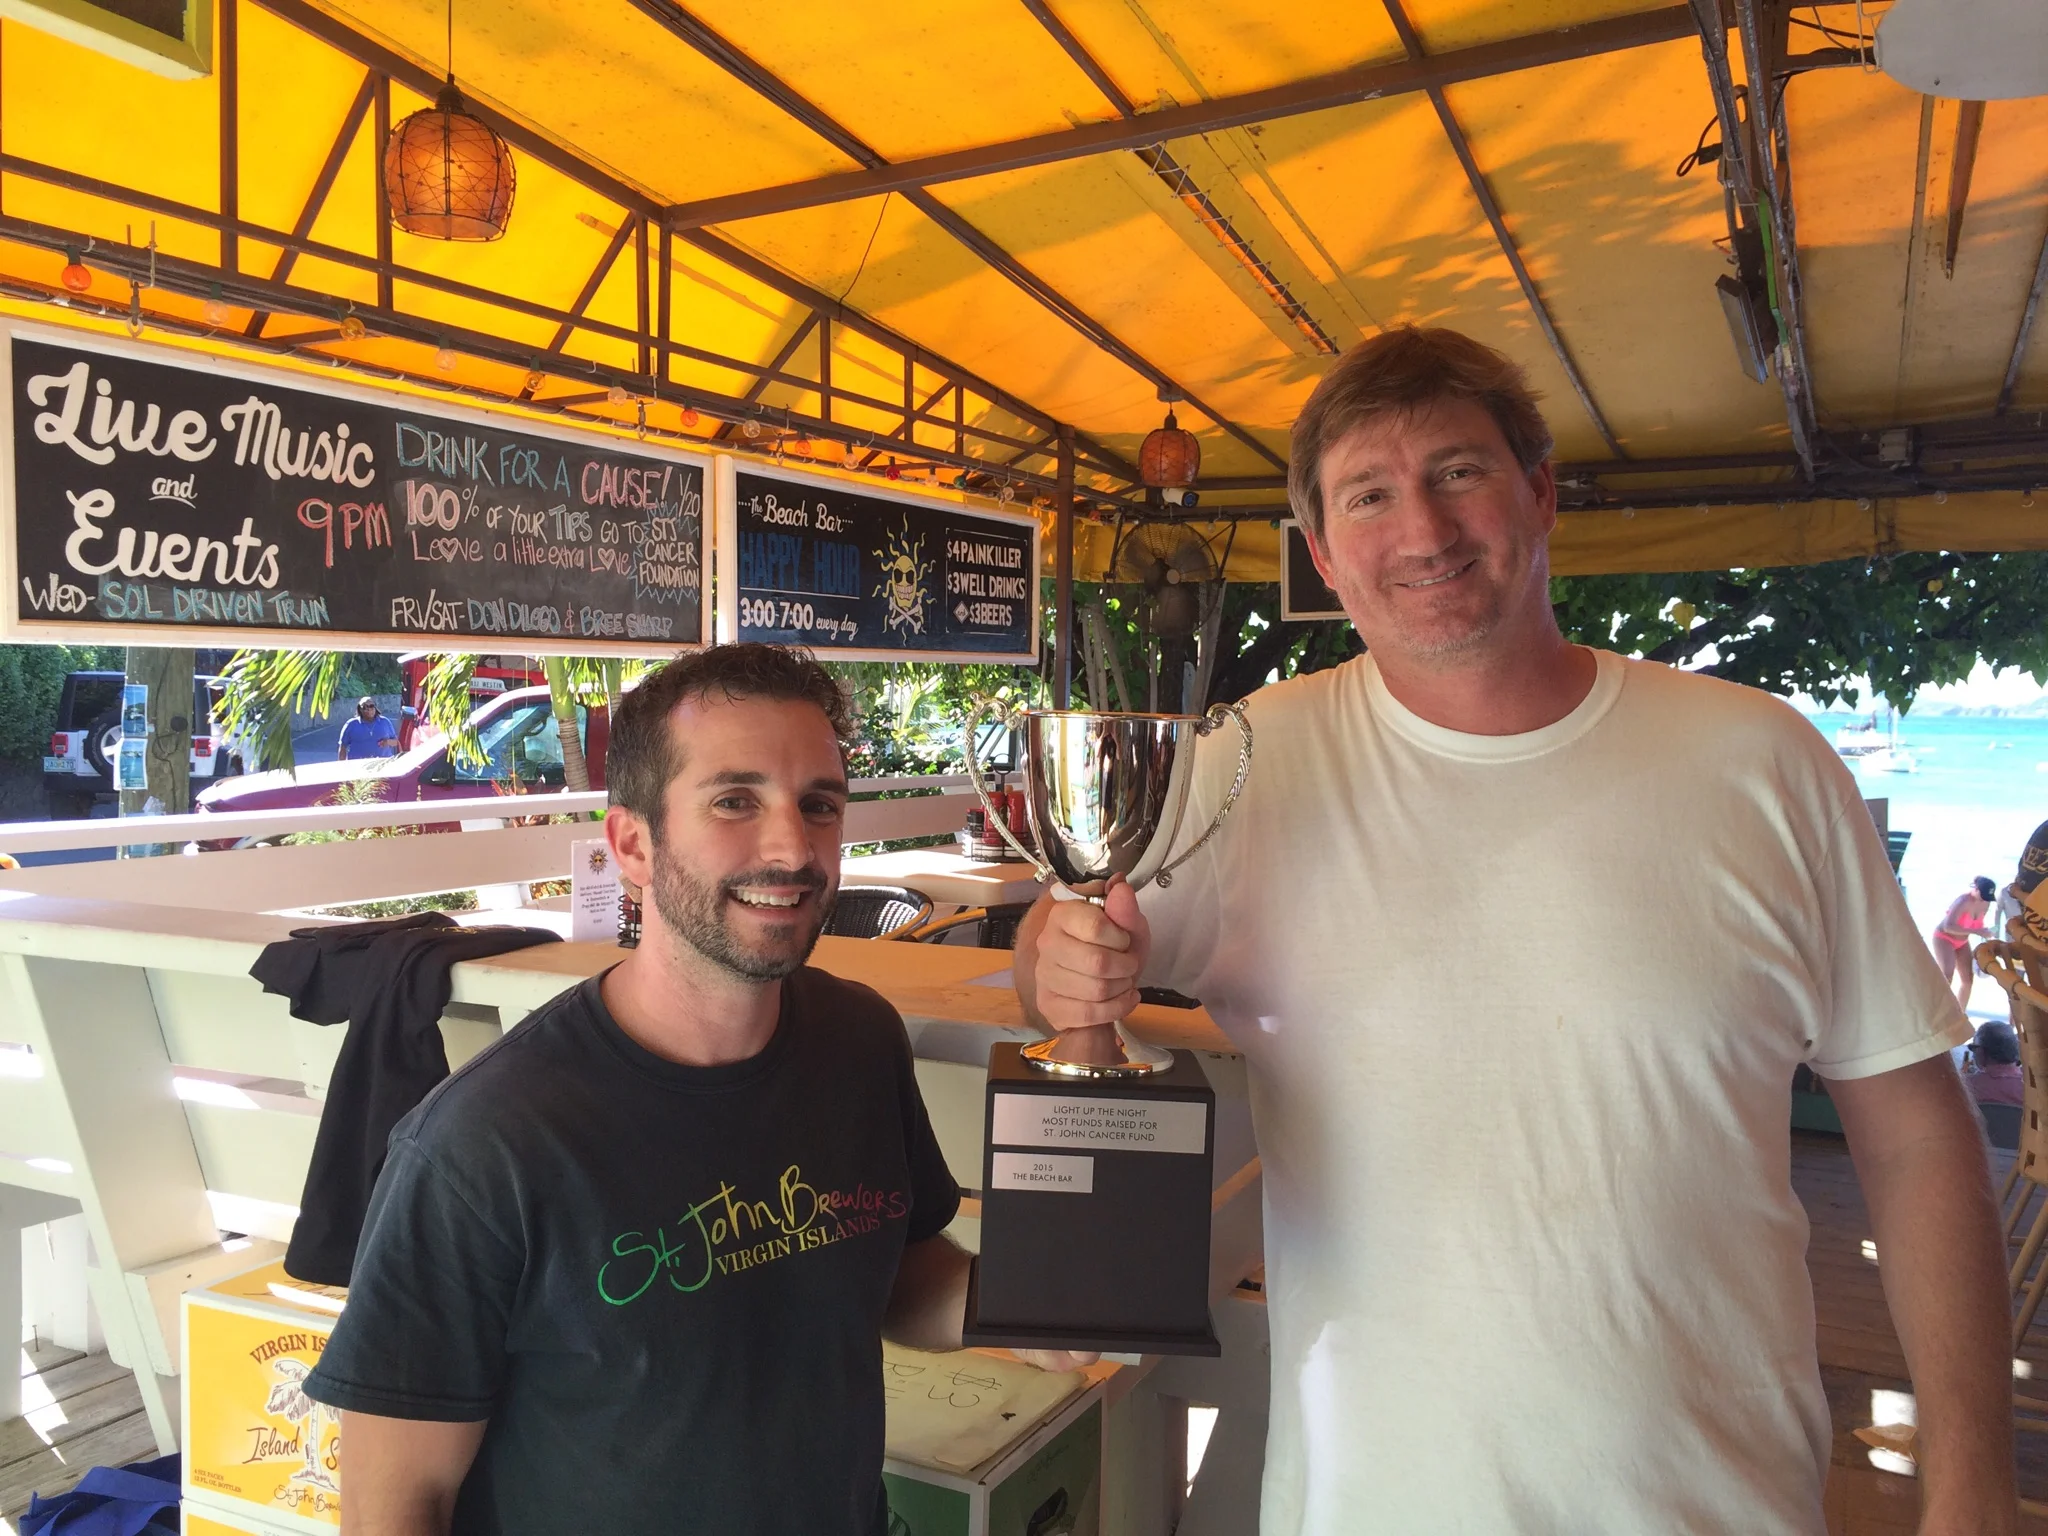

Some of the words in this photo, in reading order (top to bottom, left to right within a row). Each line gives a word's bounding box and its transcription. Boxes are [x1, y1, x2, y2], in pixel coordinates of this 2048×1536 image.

[27, 362, 217, 465] Live
[221, 396, 375, 488] Music
[396, 422, 495, 488] DRINK
[499, 444, 547, 491] FOR
[554, 456, 571, 497] A
[581, 461, 674, 510] CAUSE!
[151, 474, 198, 499] and
[406, 480, 480, 531] 100%
[486, 506, 503, 530] OF
[508, 504, 548, 544] YOUR
[548, 504, 593, 542] TIPS
[600, 521, 620, 544] GO
[621, 522, 644, 545] TO
[763, 494, 809, 528] Beach
[65, 489, 280, 588] Events
[651, 517, 677, 541] STJ
[494, 542, 507, 562] a
[512, 536, 547, 566] little
[548, 546, 584, 569] extra
[645, 539, 699, 566] CANCER
[740, 531, 803, 592] HAPPY
[814, 540, 860, 596] HOUR
[640, 561, 700, 589] FOUNDATION
[989, 575, 1026, 600] DRINKS
[103, 581, 163, 619] SOL
[268, 591, 330, 627] TRAIN
[467, 598, 508, 632] DON
[564, 602, 575, 634] &
[580, 605, 625, 638] BREE
[816, 616, 839, 642] every
[841, 613, 859, 642] day
[1041, 1117, 1069, 1127] MOST
[1071, 1118, 1103, 1128] FUNDS
[1105, 1119, 1137, 1130] RAISED
[1139, 1121, 1158, 1131] FOR
[1053, 1106, 1081, 1115] LIGHT
[1083, 1107, 1095, 1116] UP
[1097, 1107, 1115, 1117] THE
[1117, 1108, 1147, 1118] NIGHT
[1044, 1128, 1057, 1138] ST.
[1059, 1129, 1086, 1139] JOHN
[1088, 1131, 1126, 1141] CANCER
[1129, 1132, 1155, 1142] FUND
[1013, 1172, 1028, 1181] THE
[1030, 1173, 1056, 1183] BEACH
[1058, 1175, 1073, 1183] BAR
[1033, 1163, 1053, 1172] 2015
[670, 1180, 782, 1292] John
[714, 1236, 791, 1276] VIRGIN
[797, 1212, 882, 1253] ISLANDS
[249, 1333, 308, 1365] VIRGIN
[242, 1426, 300, 1465] Island
